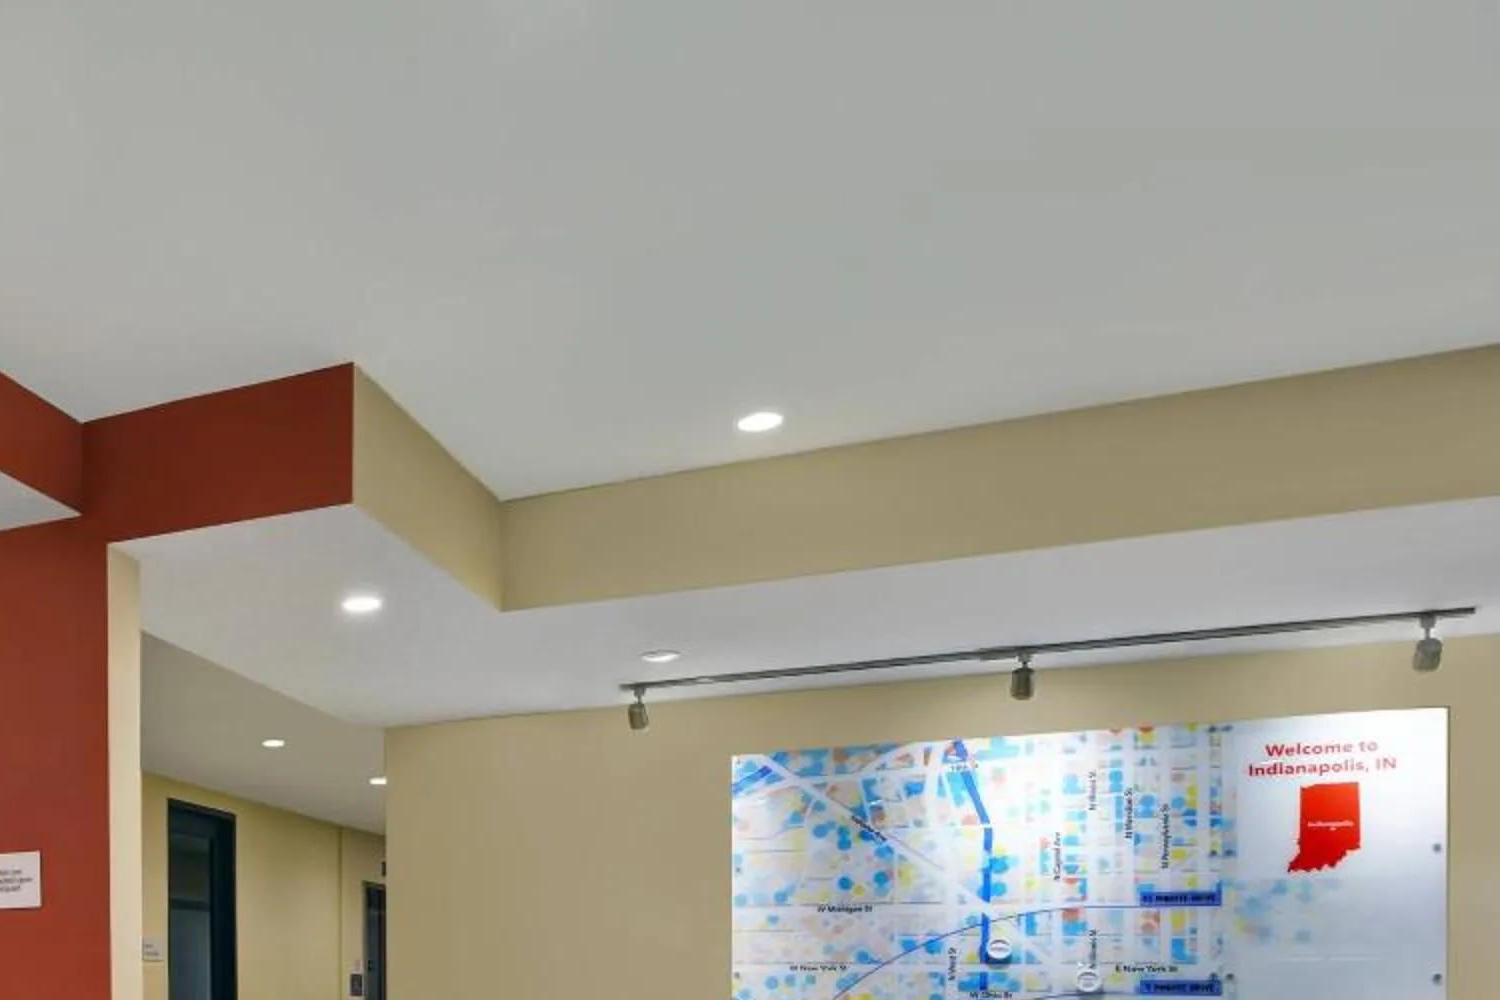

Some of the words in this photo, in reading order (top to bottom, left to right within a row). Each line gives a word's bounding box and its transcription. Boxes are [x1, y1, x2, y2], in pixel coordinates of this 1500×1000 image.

[1265, 743, 1352, 756] Welcome
[1358, 741, 1378, 752] to
[1248, 760, 1369, 777] Indianapolis,
[1376, 758, 1396, 770] IN
